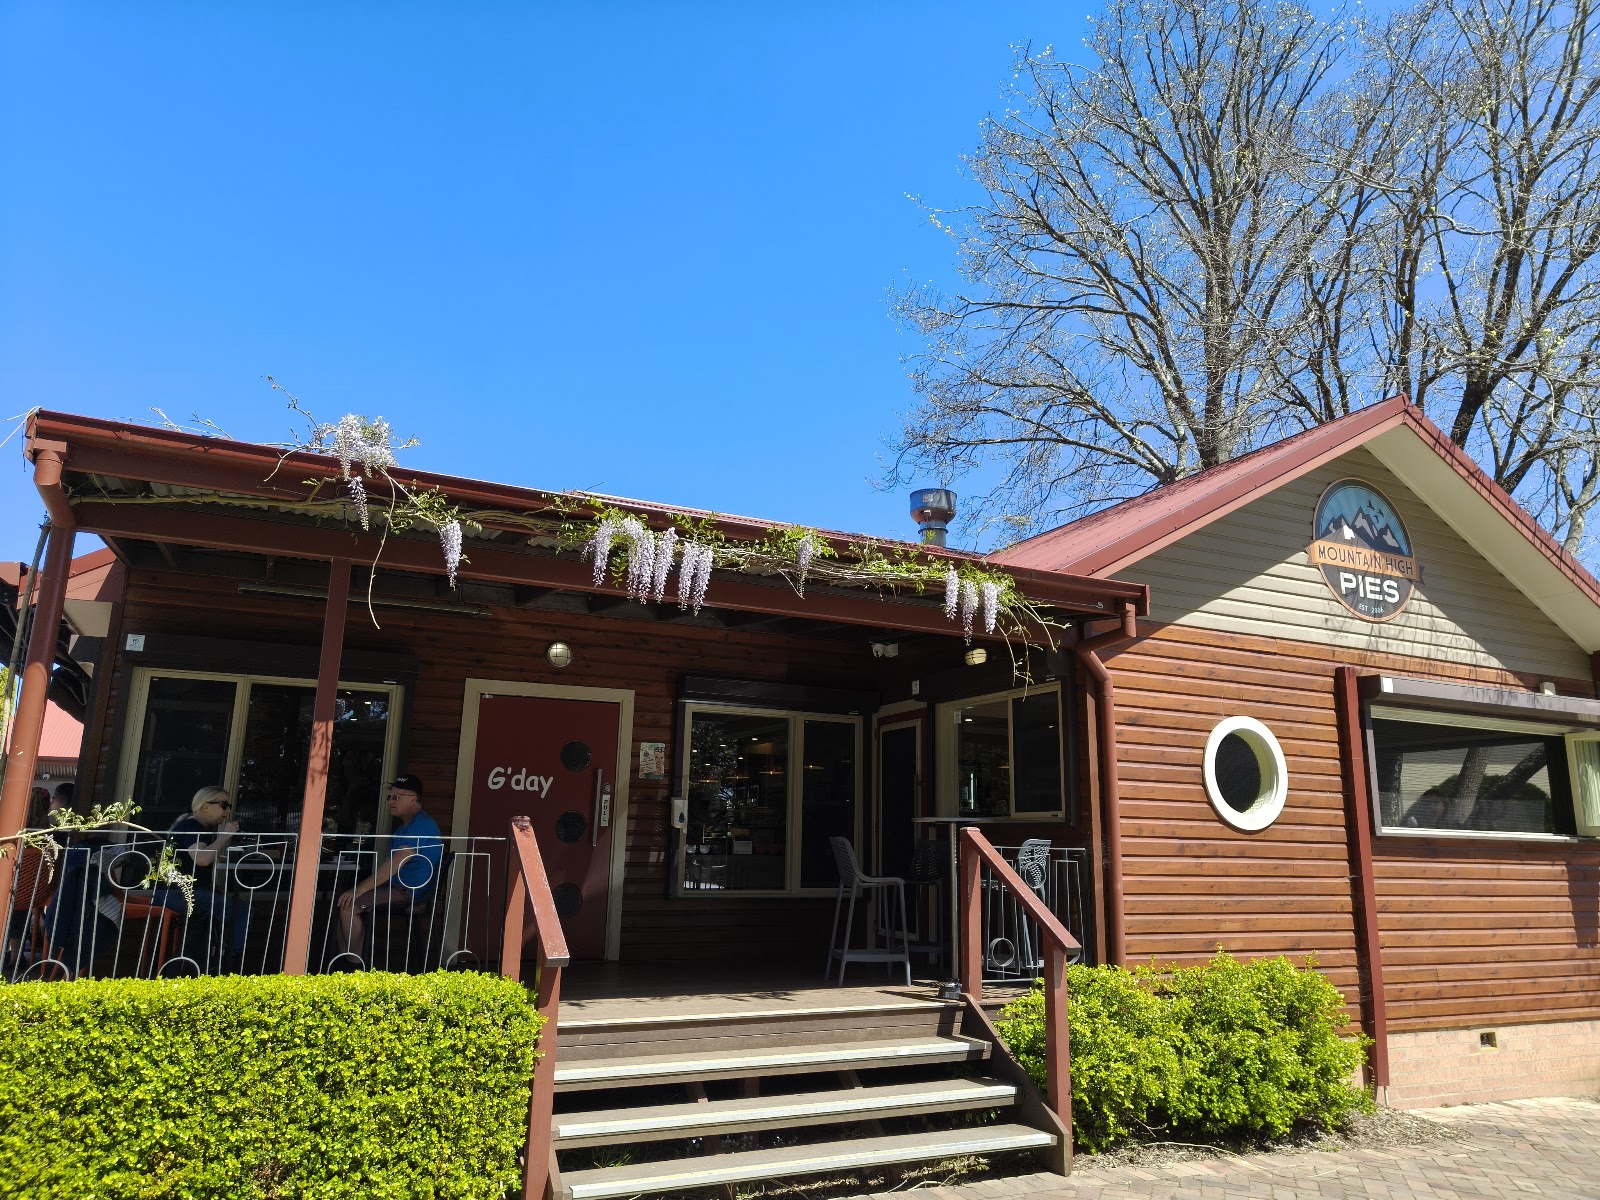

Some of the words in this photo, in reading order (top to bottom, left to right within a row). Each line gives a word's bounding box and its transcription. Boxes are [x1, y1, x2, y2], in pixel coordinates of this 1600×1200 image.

[1318, 545, 1382, 570] MOUNTAIN
[1385, 557, 1414, 576] HIGH
[1340, 571, 1400, 603] PIES
[1359, 603, 1369, 611] EST
[487, 766, 554, 799] G'day
